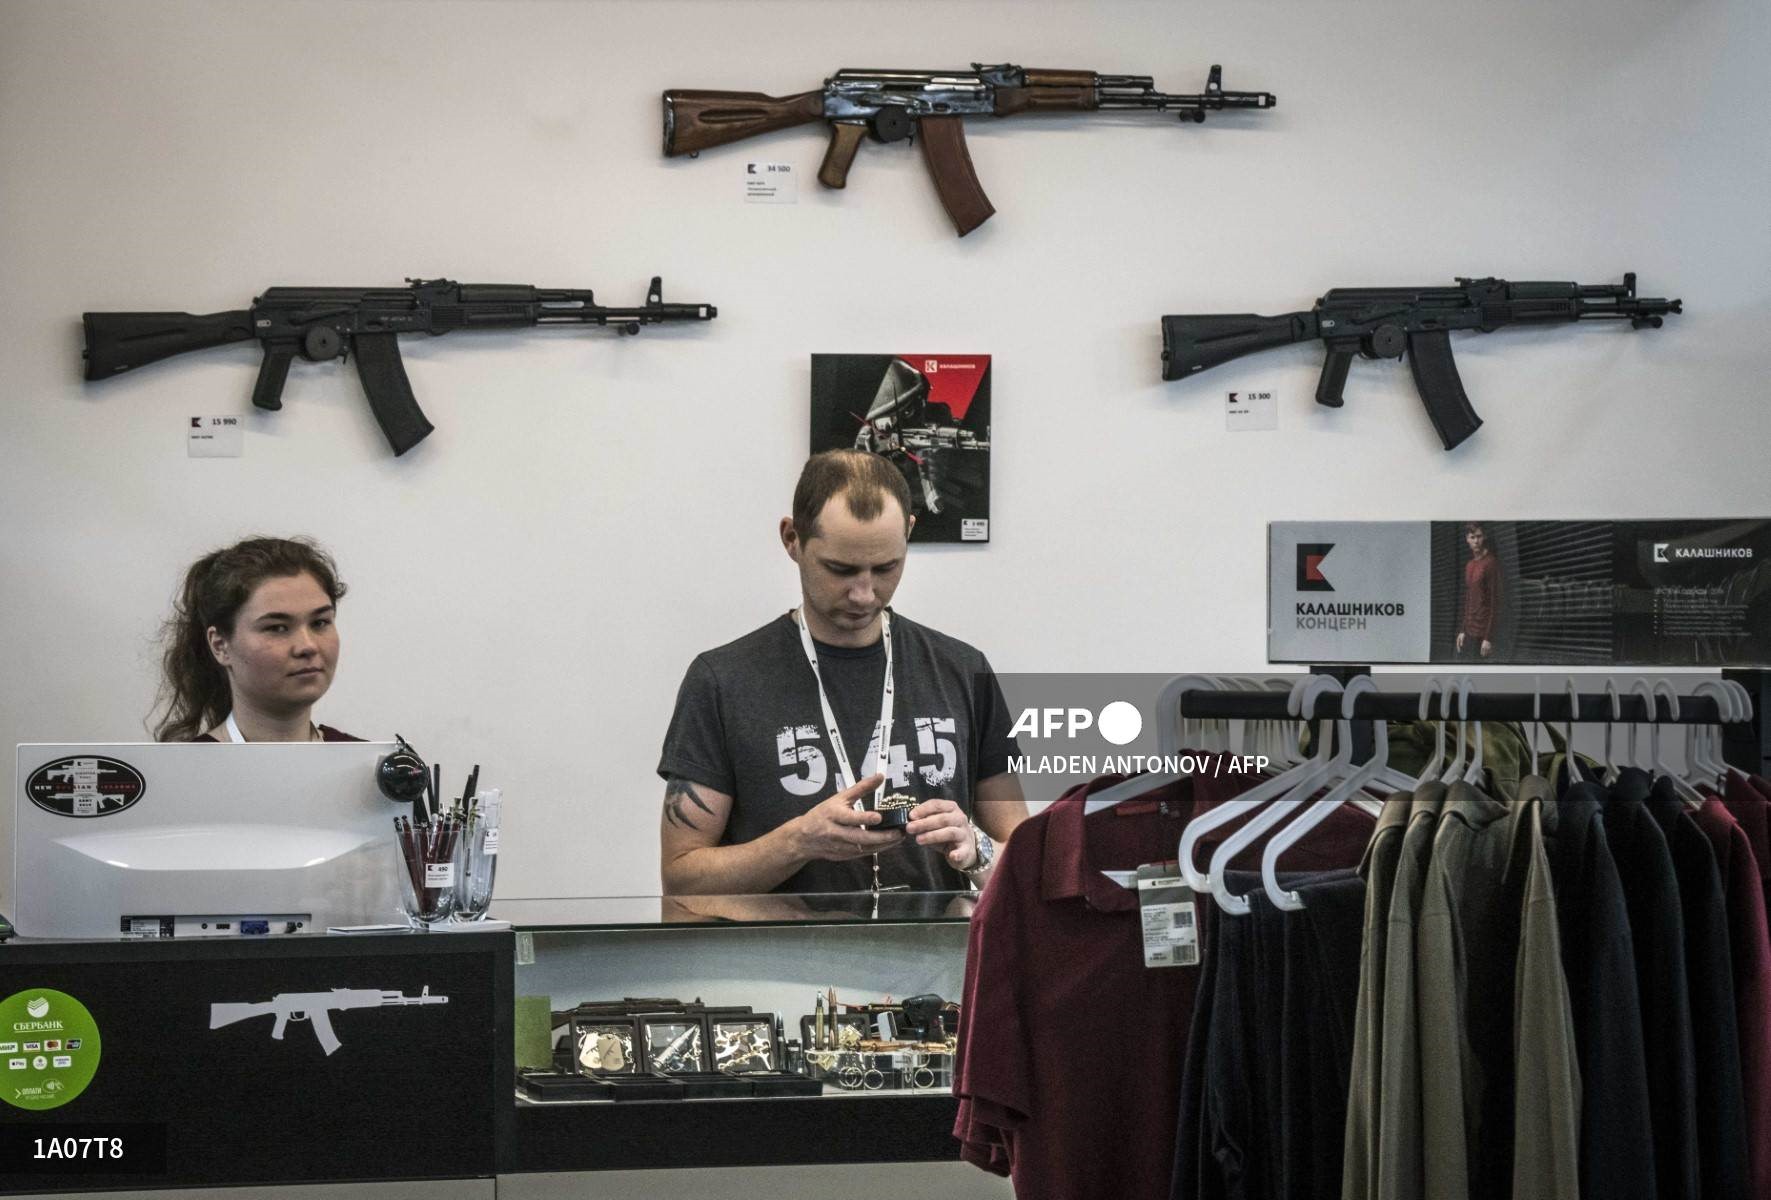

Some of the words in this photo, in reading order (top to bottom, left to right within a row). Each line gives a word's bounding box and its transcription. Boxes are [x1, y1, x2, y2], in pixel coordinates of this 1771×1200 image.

[212, 418, 222, 426] 15
[1675, 548, 1753, 558] КАЛАШНИКОВ
[1296, 603, 1405, 616] КАЛАШНИКОВ
[1296, 617, 1367, 631] КОНЦЕРН
[13, 1021, 64, 1031] СБЕРБАНК
